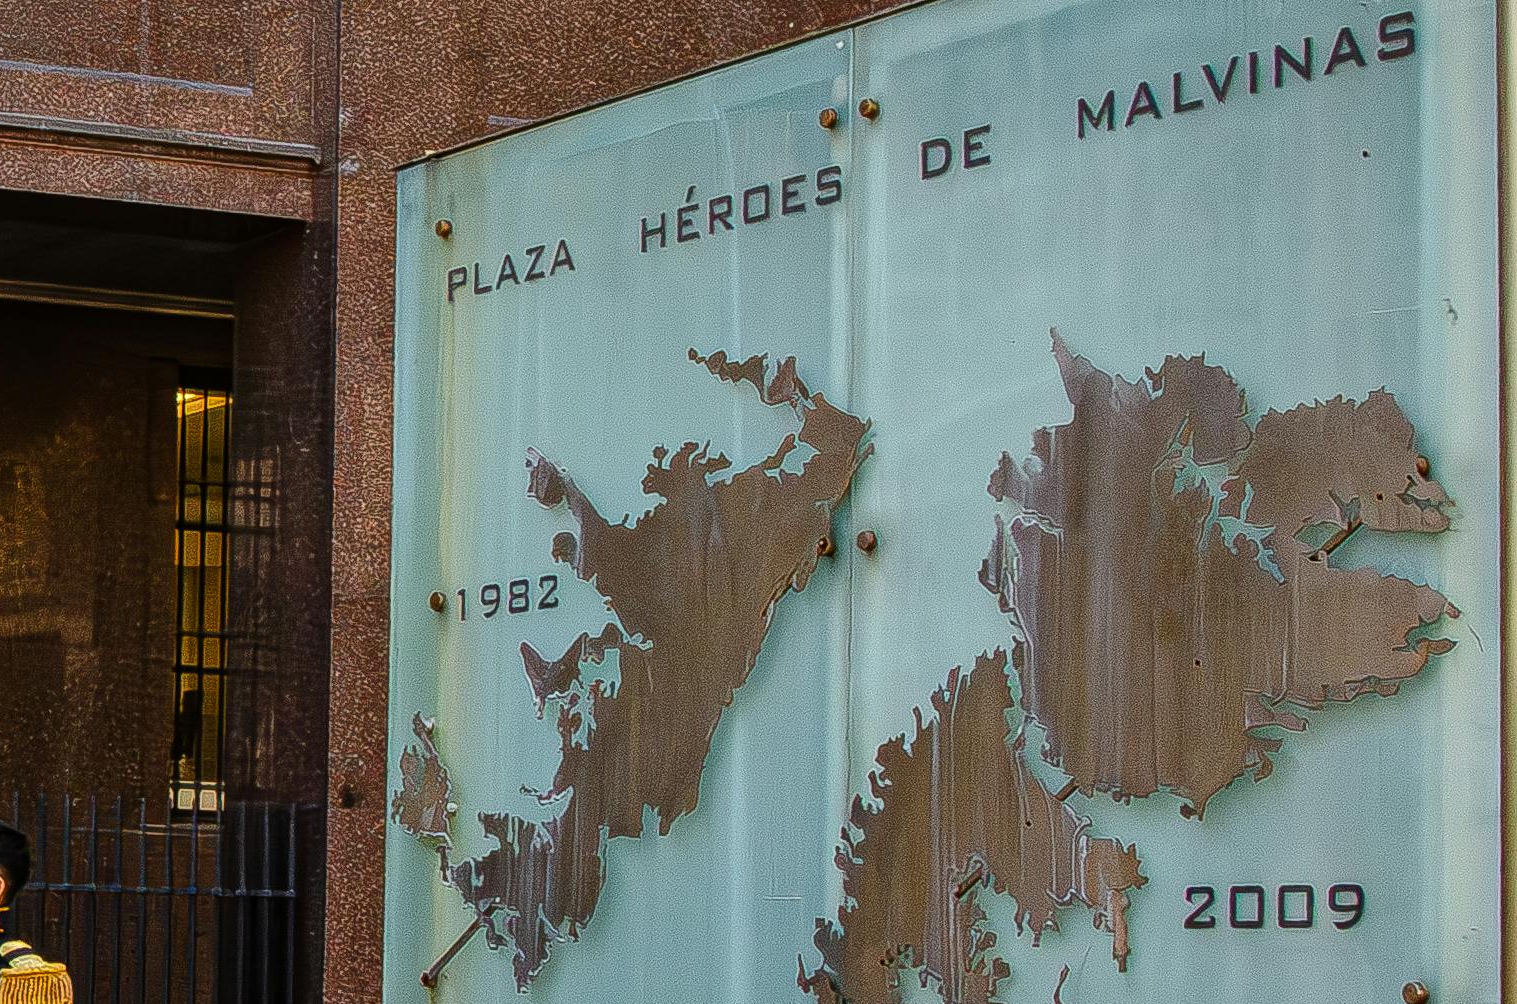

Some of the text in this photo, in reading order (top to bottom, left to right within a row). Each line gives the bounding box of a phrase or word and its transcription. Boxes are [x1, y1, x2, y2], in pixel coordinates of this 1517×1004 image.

[447, 10, 1418, 303] PLAZA HÉROES DE MALVINAS
[457, 574, 559, 622] 1982
[1183, 884, 1366, 931] 2009
